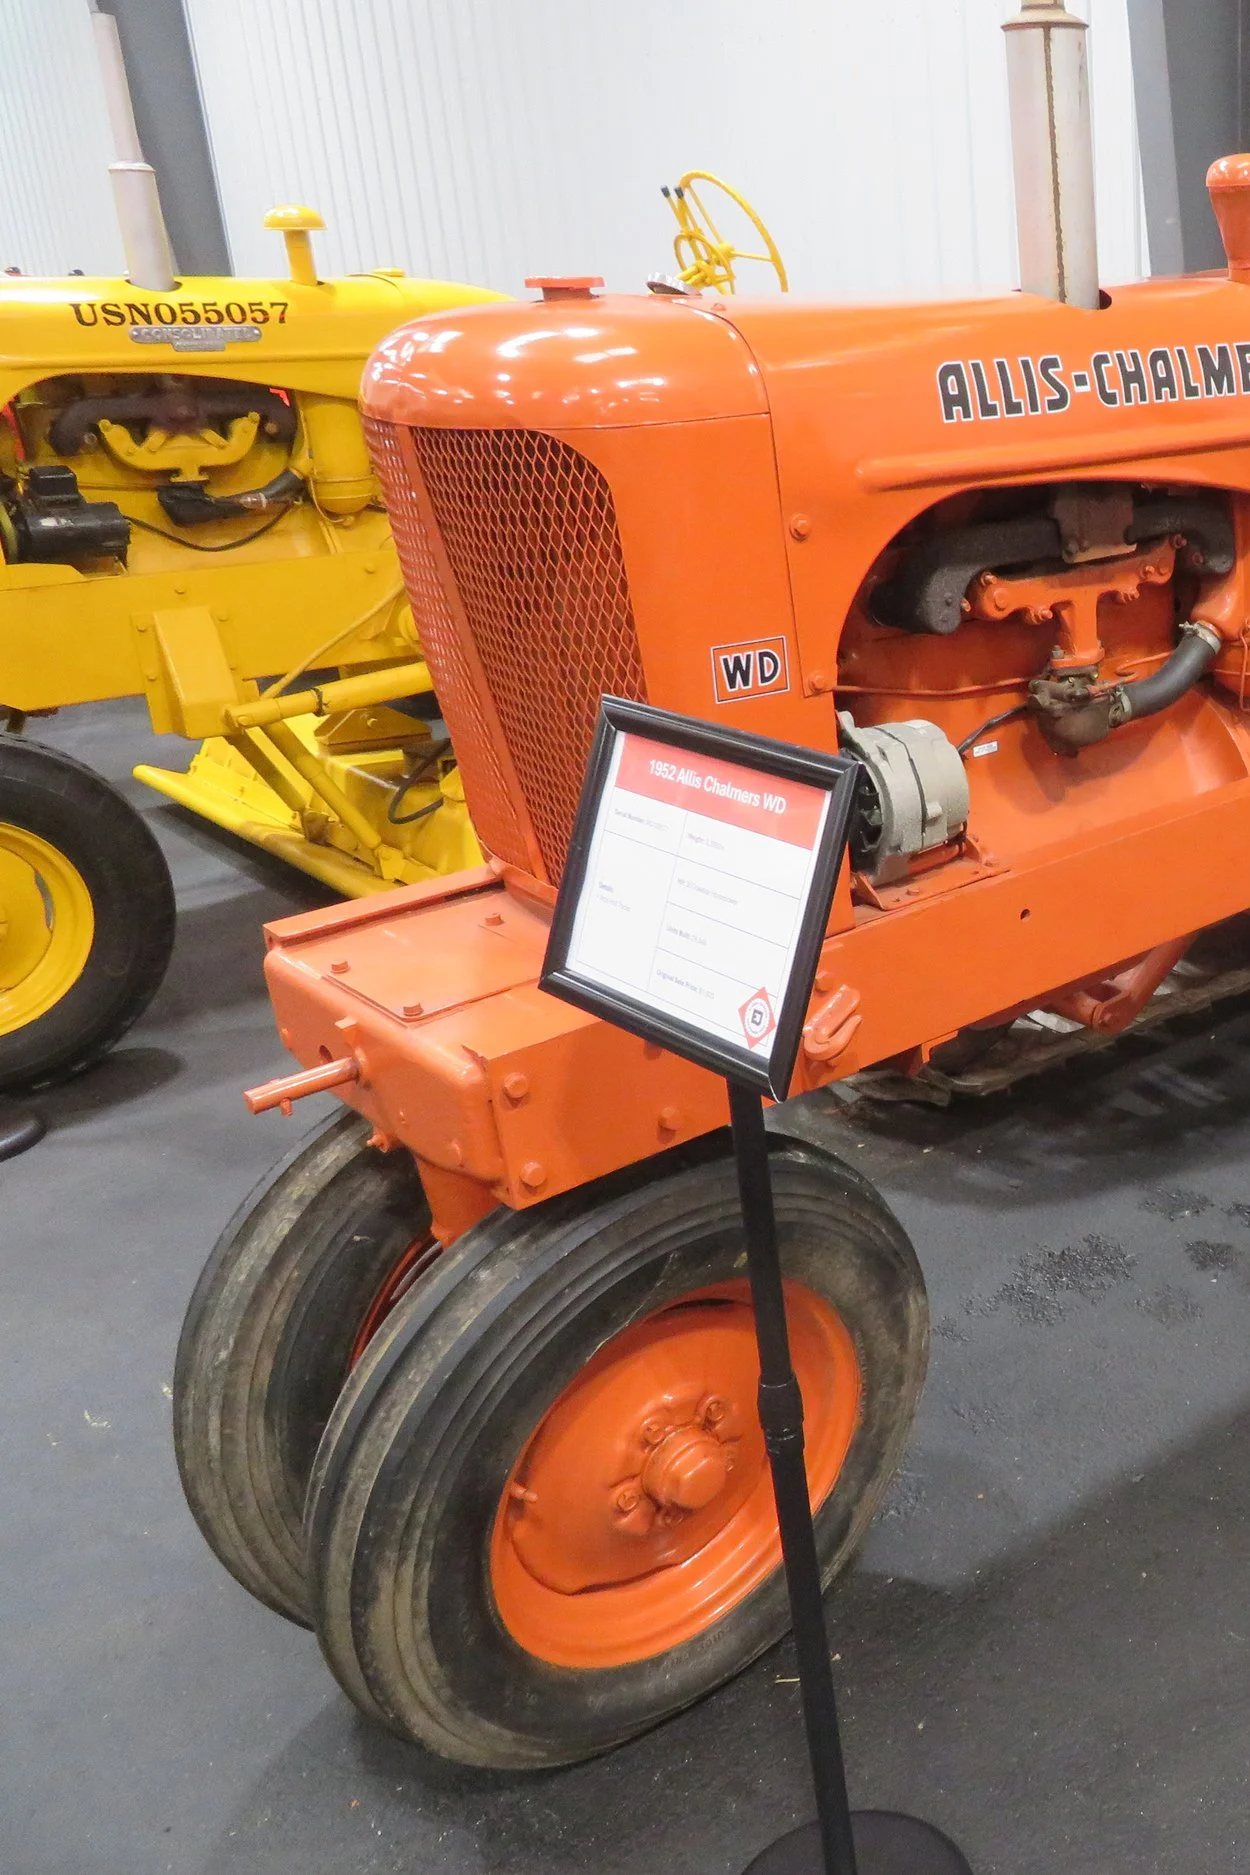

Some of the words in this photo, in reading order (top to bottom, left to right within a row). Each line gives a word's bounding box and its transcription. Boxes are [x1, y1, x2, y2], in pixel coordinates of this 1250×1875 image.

[720, 648, 781, 692] WD
[649, 759, 677, 781] 1952
[676, 767, 702, 790] Allis
[703, 775, 761, 808] Chalmers
[763, 791, 787, 814] WD
